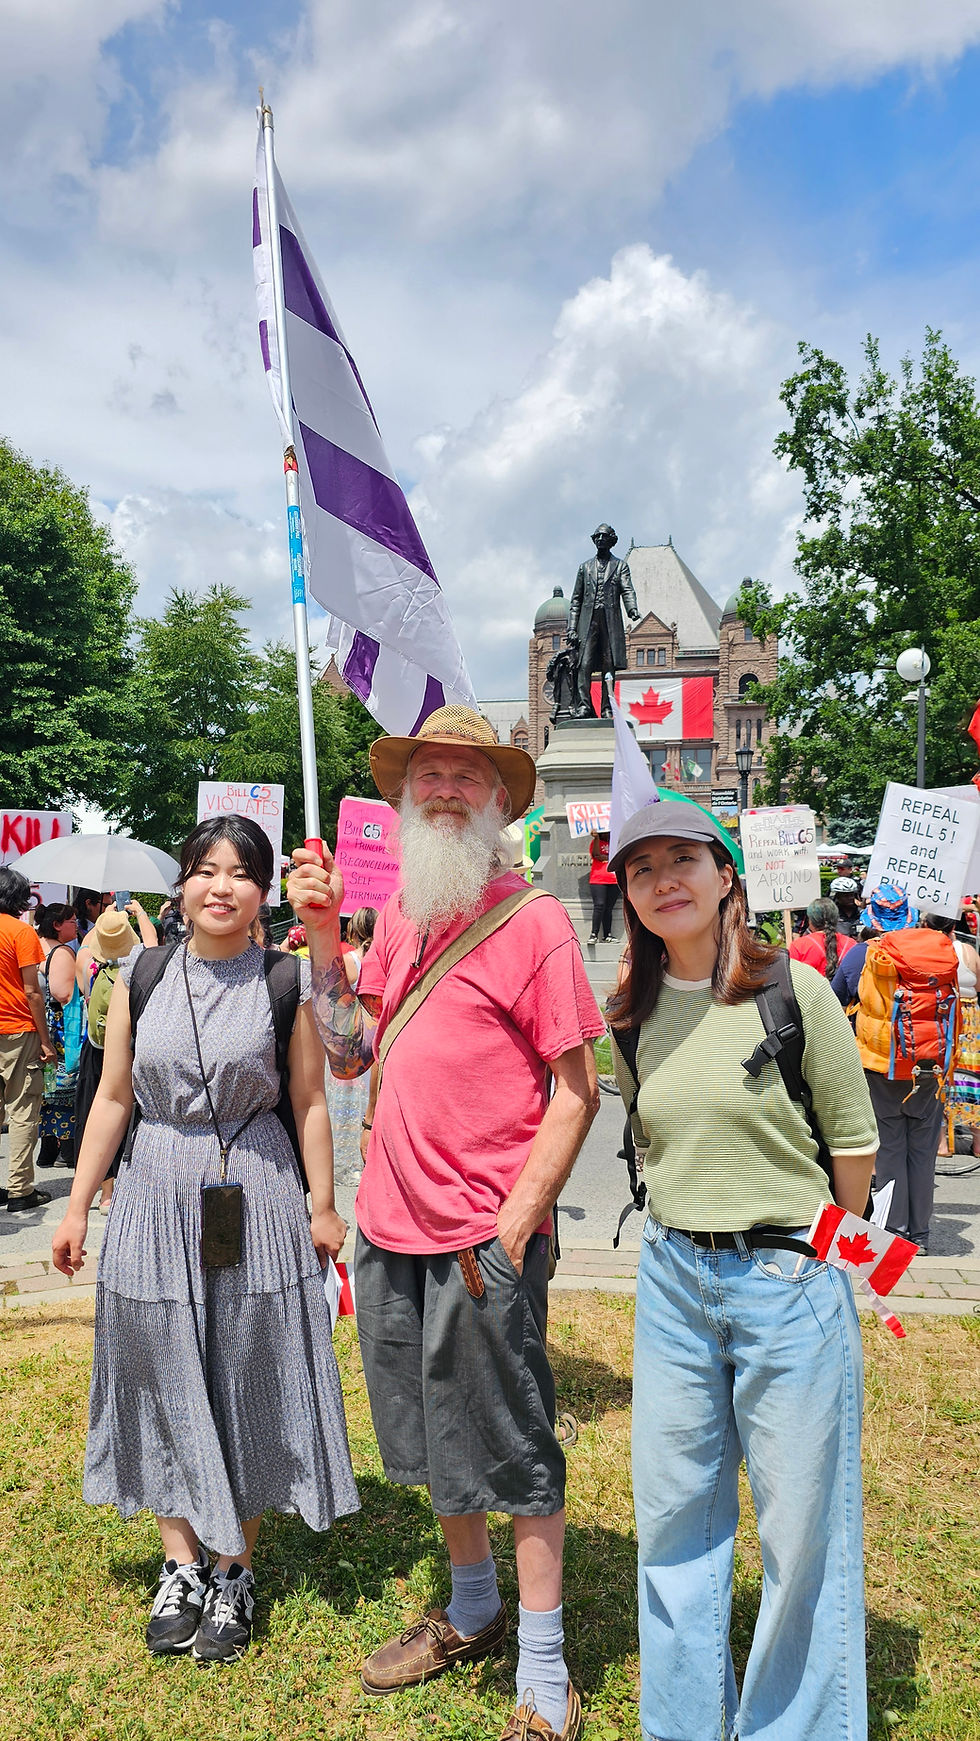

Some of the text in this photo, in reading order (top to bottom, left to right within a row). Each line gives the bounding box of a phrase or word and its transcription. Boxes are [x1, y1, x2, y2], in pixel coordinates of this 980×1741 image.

[205, 794, 279, 816] VIOLATES
[901, 797, 960, 825] REPEAL
[363, 824, 381, 839] C5
[901, 818, 956, 844] BILL 5 !
[910, 844, 938, 860] and
[765, 860, 785, 871] NOT
[886, 857, 946, 884] REPEAL
[757, 869, 812, 888] AROUND
[773, 886, 793, 903] US
[917, 886, 941, 903] C-5
[944, 892, 950, 906] !
